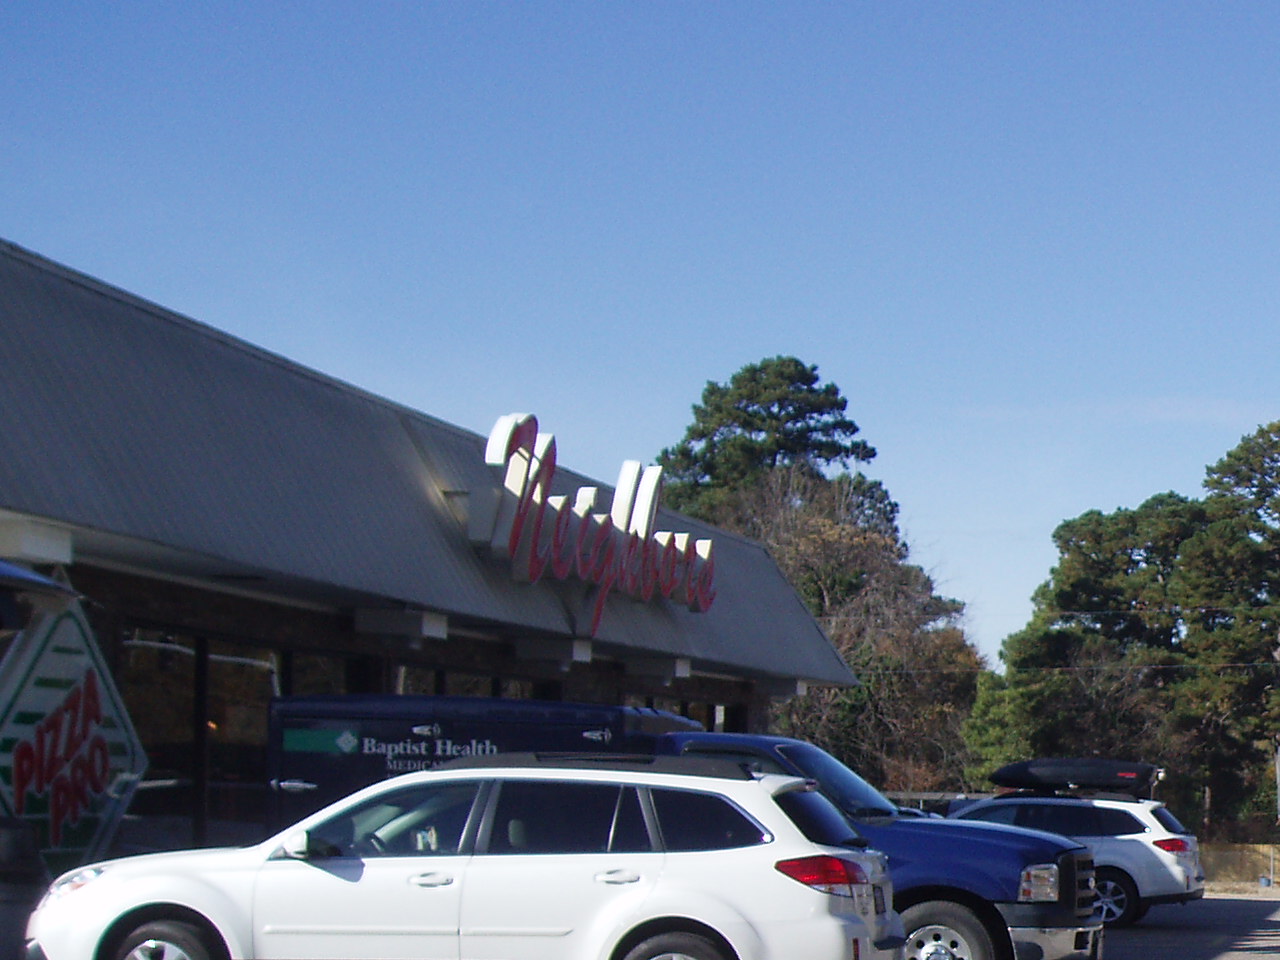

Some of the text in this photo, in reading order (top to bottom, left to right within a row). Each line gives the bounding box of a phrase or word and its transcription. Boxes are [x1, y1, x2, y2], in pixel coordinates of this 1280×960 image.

[12, 667, 102, 815] PIZZA
[50, 735, 110, 847] PRO
[364, 738, 497, 758] Baptist Health
